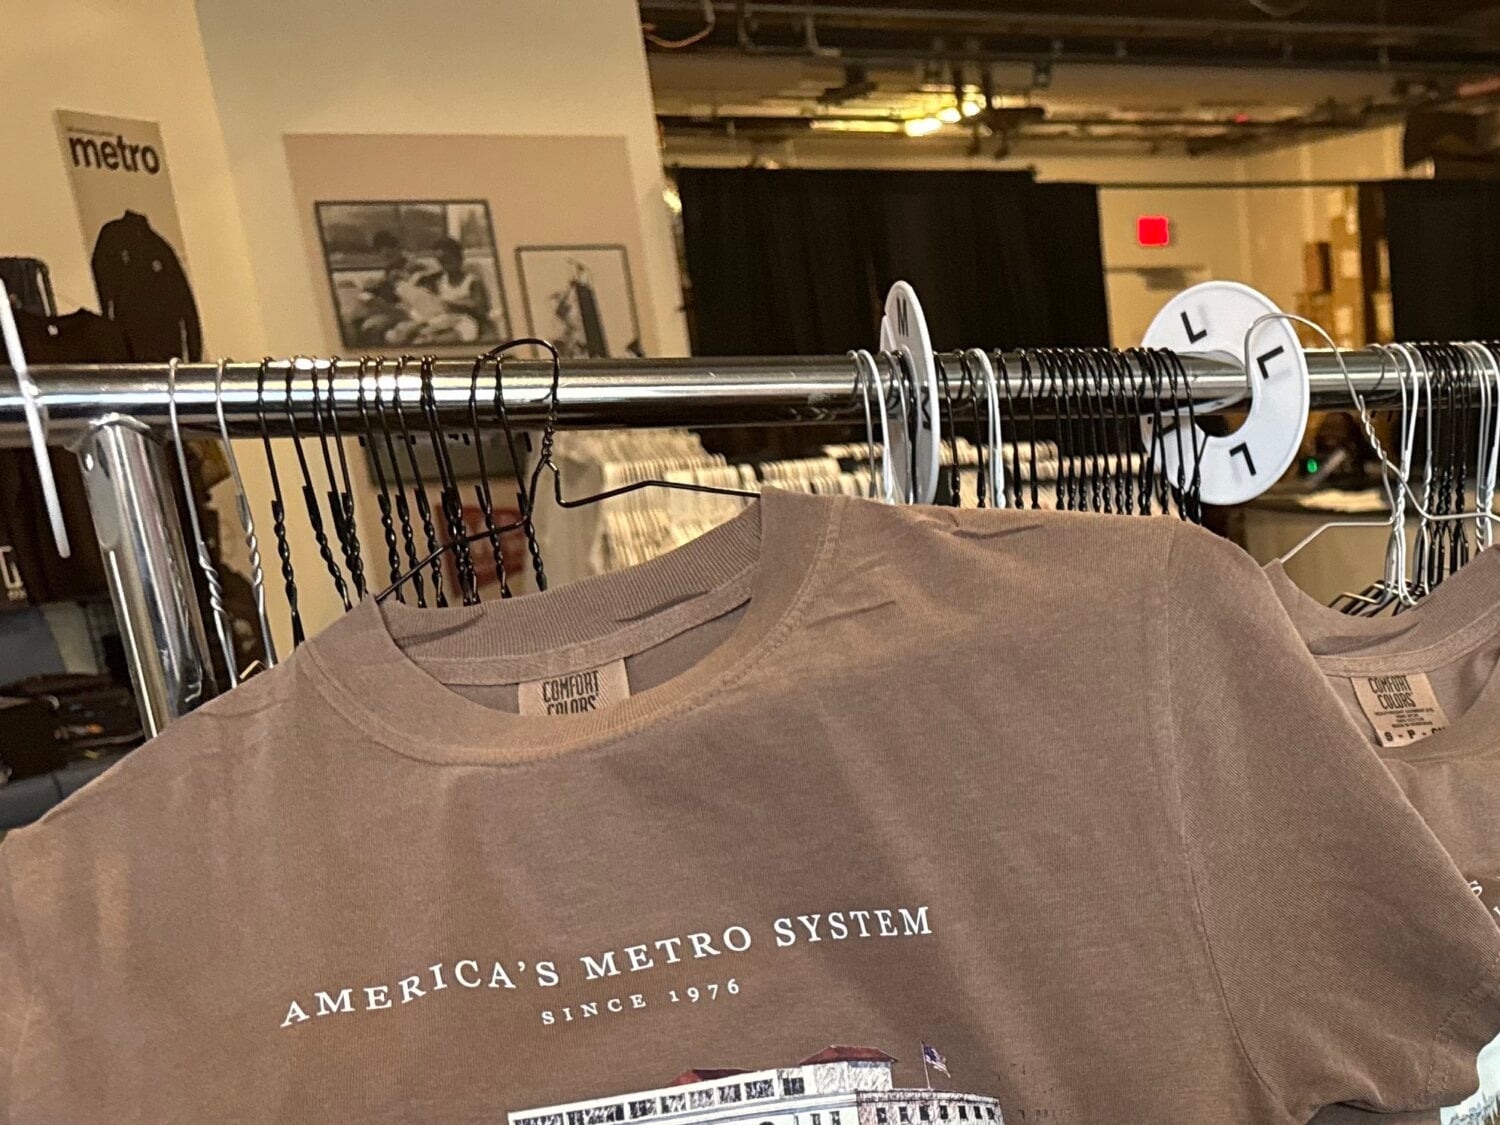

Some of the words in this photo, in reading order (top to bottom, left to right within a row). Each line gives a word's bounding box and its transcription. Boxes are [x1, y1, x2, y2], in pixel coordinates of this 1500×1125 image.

[69, 134, 160, 175] metro
[896, 296, 909, 338] M
[1181, 311, 1208, 344] L
[1256, 345, 1285, 380] L
[1229, 442, 1257, 476] L
[543, 669, 599, 703] COMFORT
[1368, 675, 1412, 694] COMFORT
[1377, 692, 1416, 710] COLORS
[280, 959, 559, 1028] AMERICA'S
[580, 926, 752, 980] METRO
[773, 906, 932, 947] SYSTEM
[541, 993, 646, 1026] SINCE
[669, 978, 740, 1003] 1976
